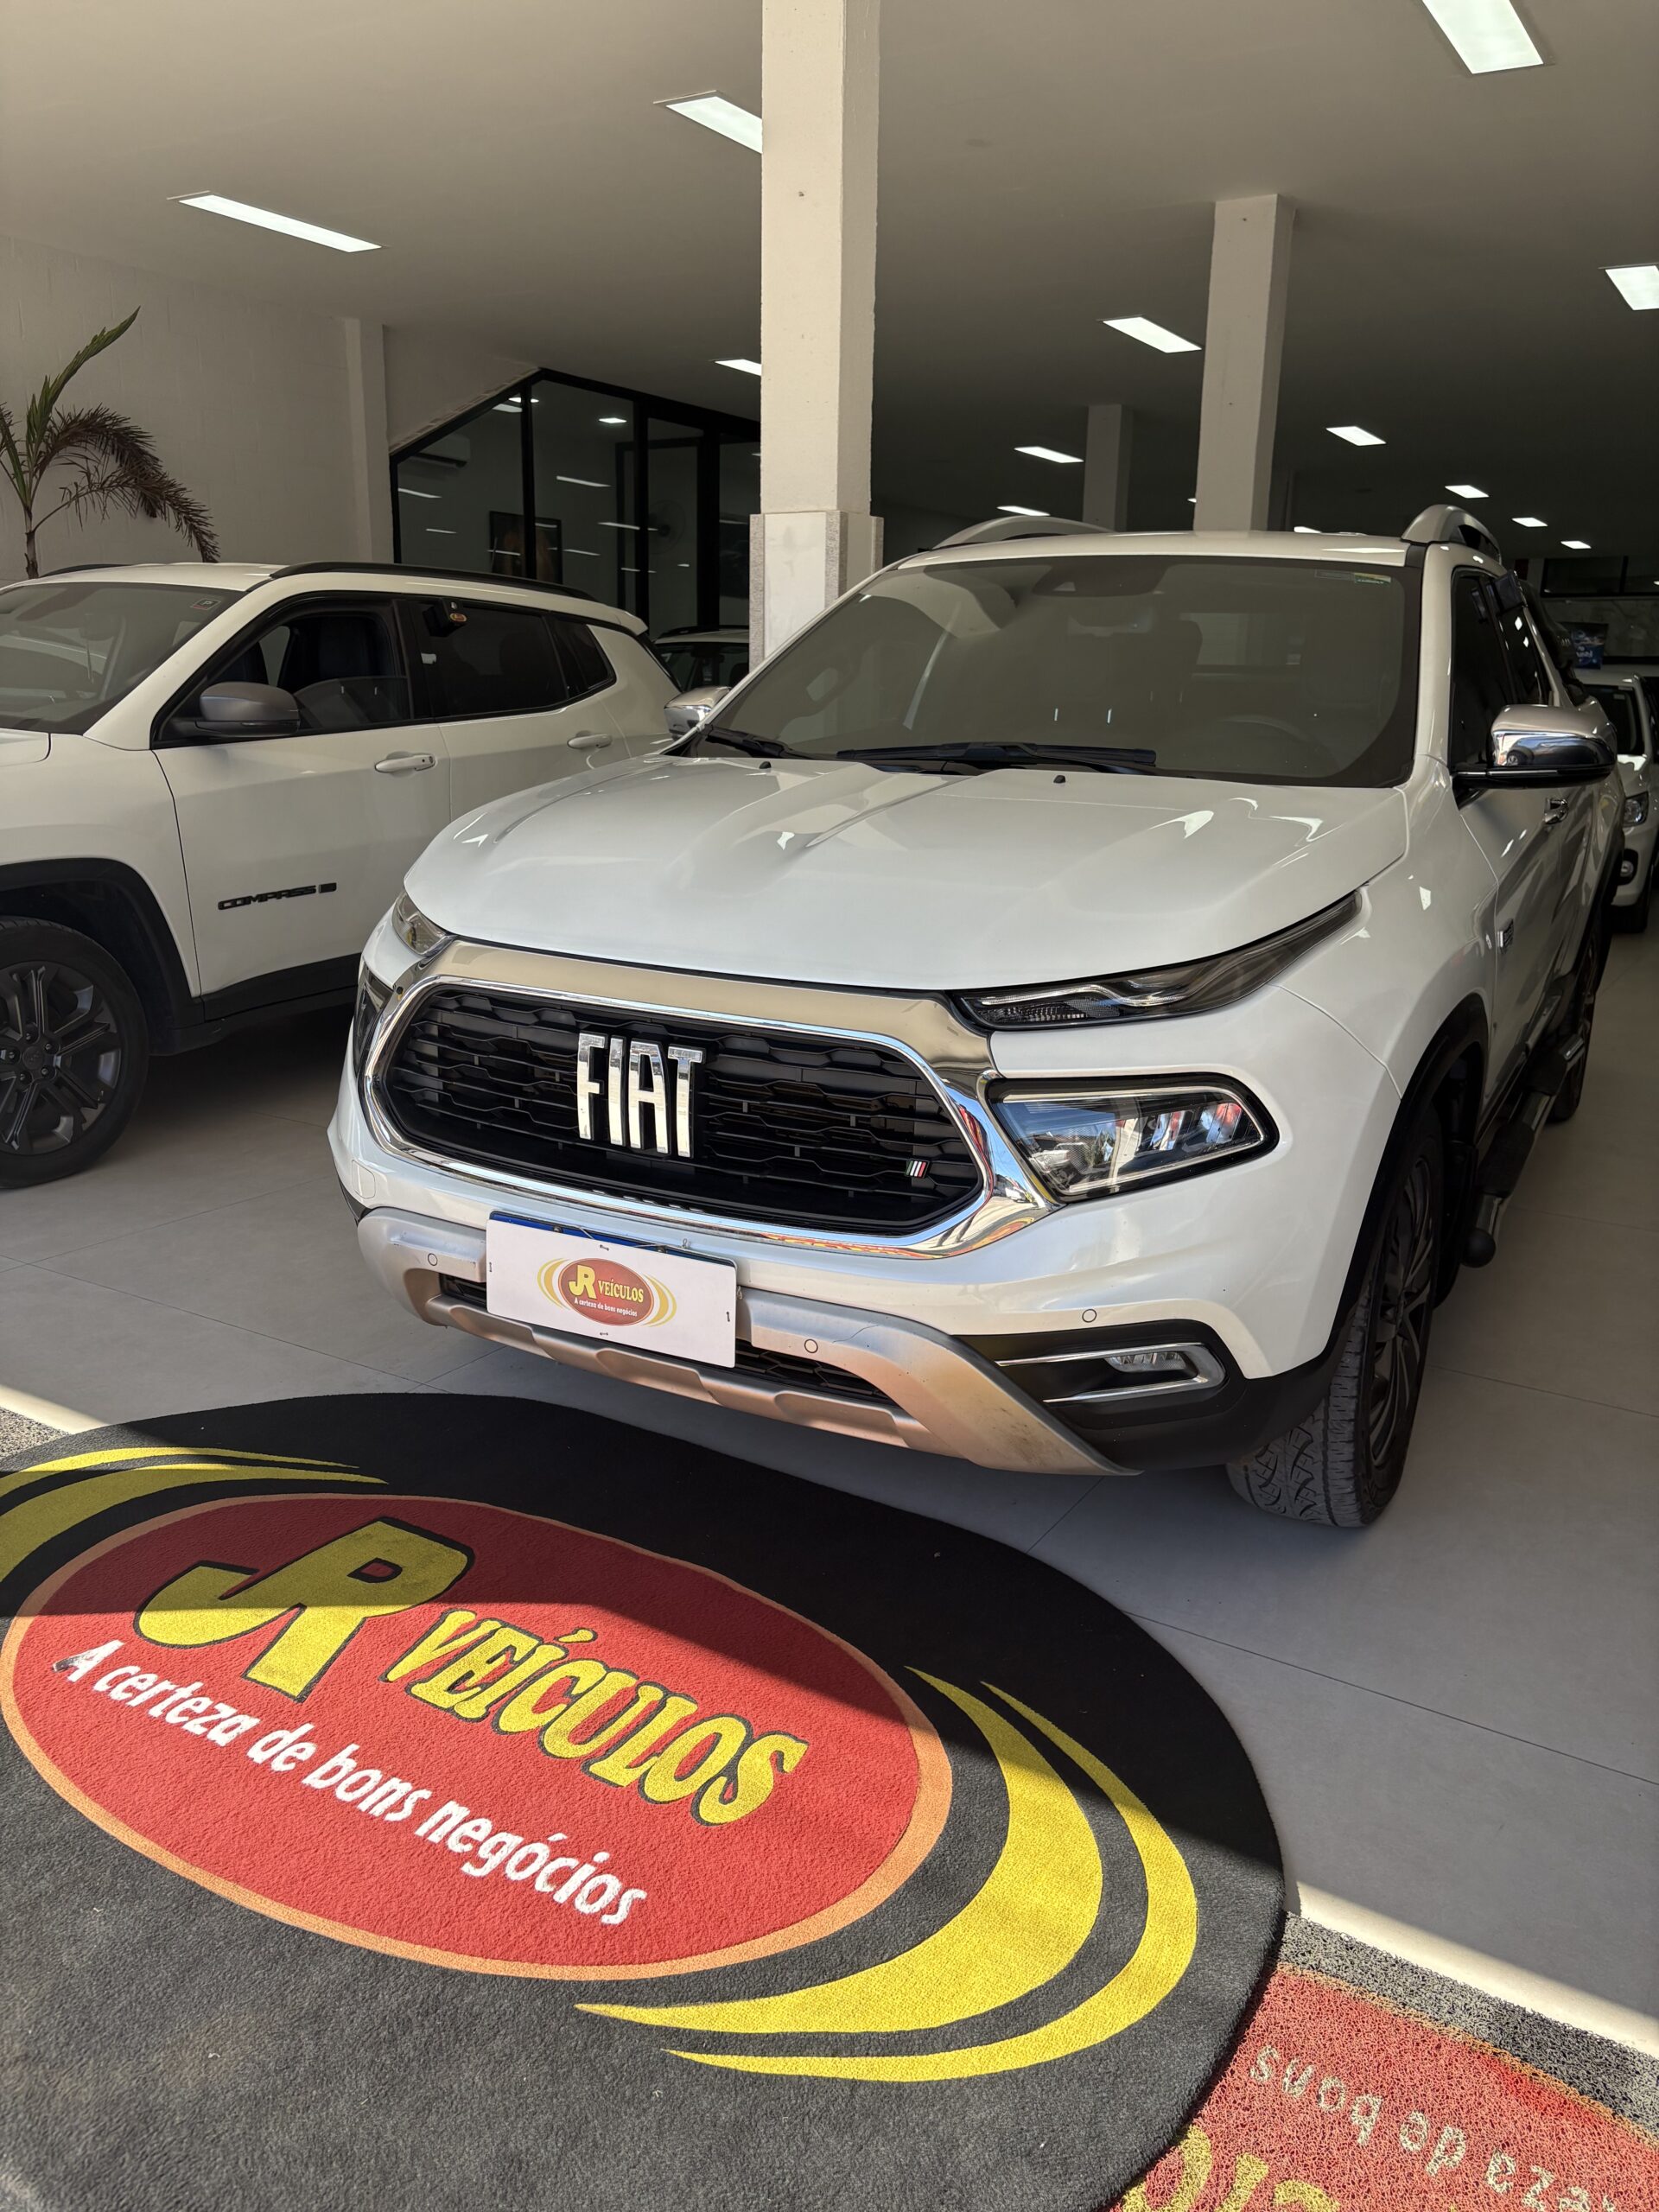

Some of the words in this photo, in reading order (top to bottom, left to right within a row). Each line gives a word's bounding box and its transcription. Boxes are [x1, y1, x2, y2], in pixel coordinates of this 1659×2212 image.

[577, 1033, 704, 1158] FIAT
[569, 1264, 597, 1300] JR
[598, 1278, 644, 1303] VEÍCULOS
[579, 1300, 597, 1309] certeza
[616, 1306, 638, 1317] negócios
[133, 1517, 474, 1703] JR
[380, 1609, 810, 1826] VEÍCULOS
[54, 1639, 124, 1682] A
[93, 1665, 260, 1747] certeza
[247, 1723, 316, 1771] de
[302, 1744, 432, 1822] bons
[415, 1799, 647, 1925] negócios
[1250, 2044, 1383, 2146] bons
[1398, 2112, 1466, 2177] de
